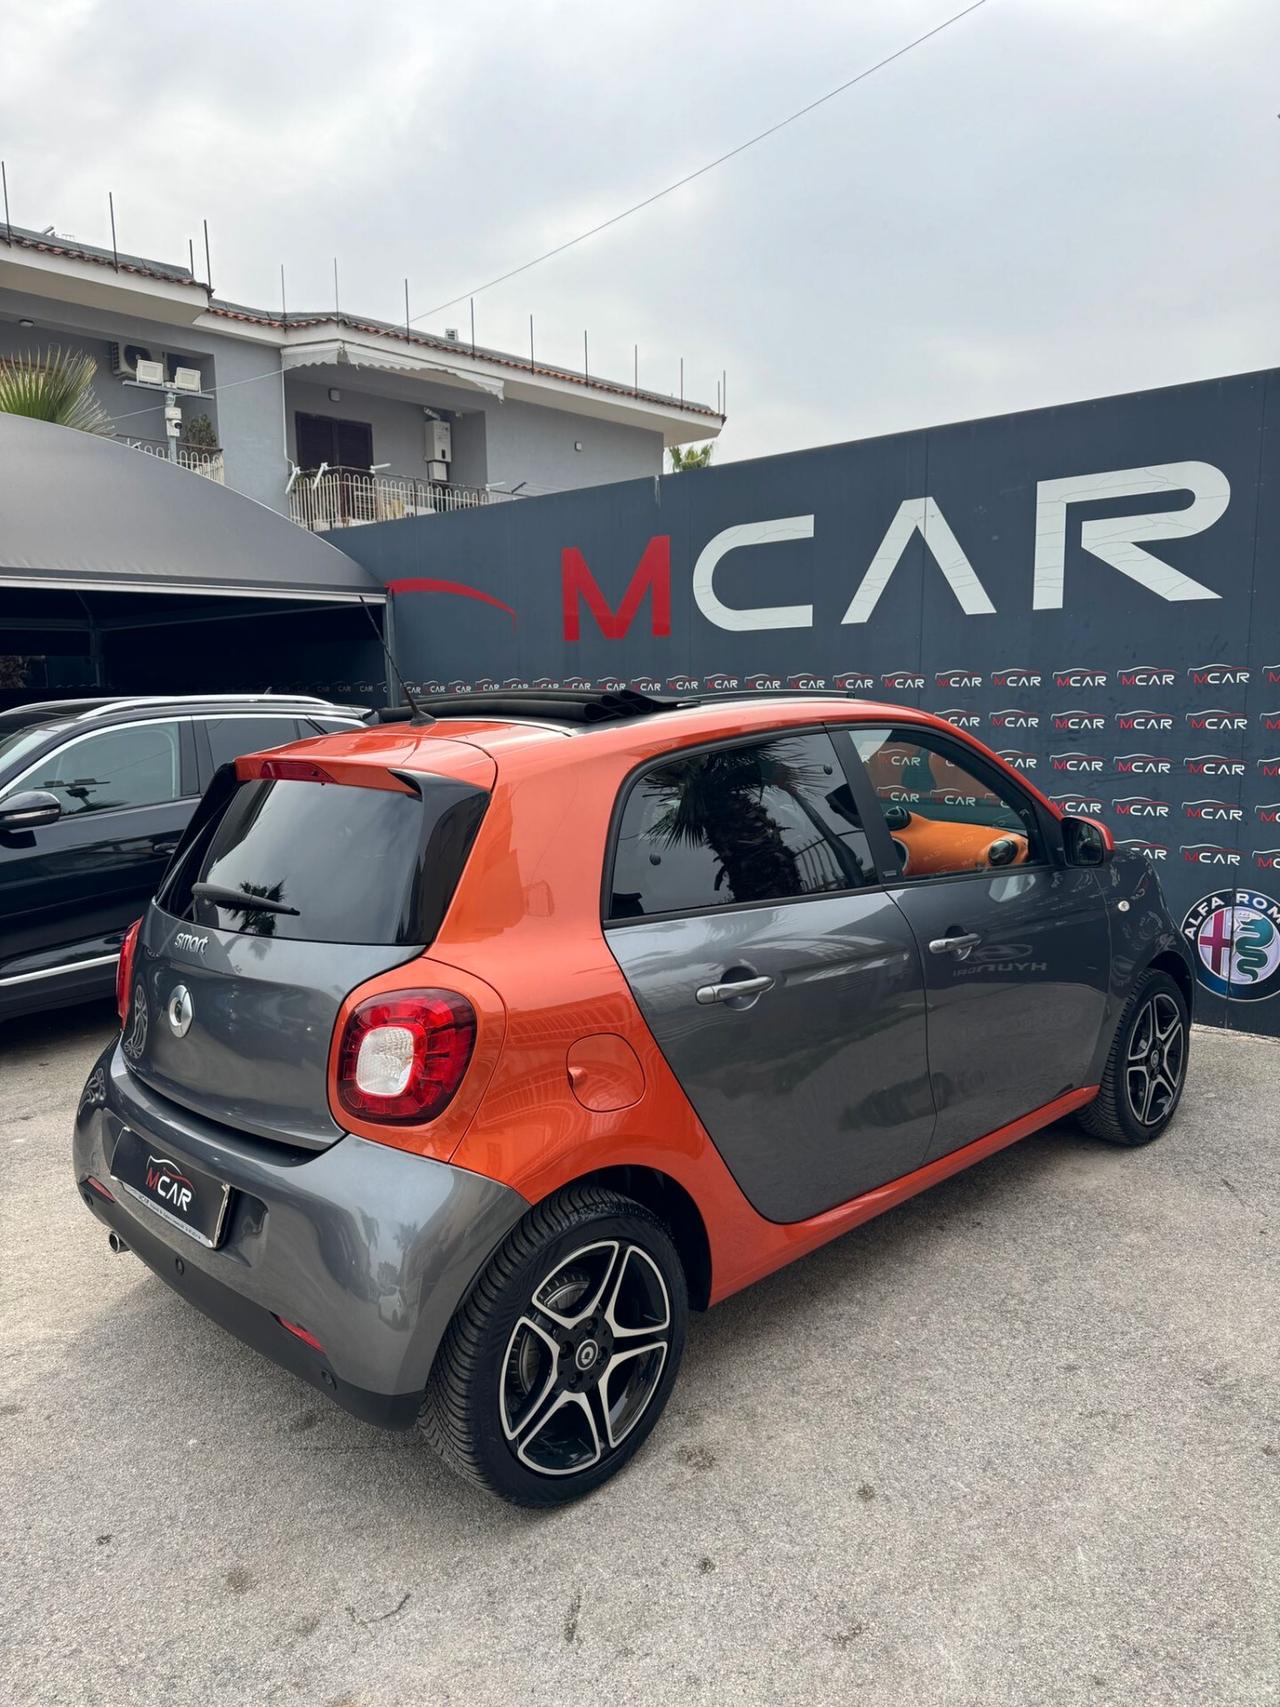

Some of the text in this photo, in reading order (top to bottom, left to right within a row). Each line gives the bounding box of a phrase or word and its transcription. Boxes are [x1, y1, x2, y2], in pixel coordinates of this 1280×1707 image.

[836, 678, 874, 689] MCAR
[884, 678, 925, 689] MCAR
[936, 676, 982, 688] MCAR
[993, 676, 1042, 687] MCAR
[1056, 675, 1107, 687] MCAR
[1122, 674, 1176, 686] MCAR
[1194, 672, 1250, 684] MCAR
[948, 716, 981, 728] CAR
[991, 717, 1040, 728] MCAR
[1055, 718, 1105, 730] MCAR
[1120, 718, 1173, 730] MCAR
[1191, 718, 1248, 730] MCAR
[1053, 760, 1103, 772] MCAR
[1118, 761, 1171, 774] MCAR
[1188, 763, 1245, 776] MCAR
[1116, 804, 1169, 817] MCAR
[1187, 807, 1243, 821] MCAR
[1184, 851, 1241, 866] MCAR
[1184, 896, 1225, 941] ALFA
[174, 932, 209, 955] smart
[145, 1166, 193, 1212] MCAR
